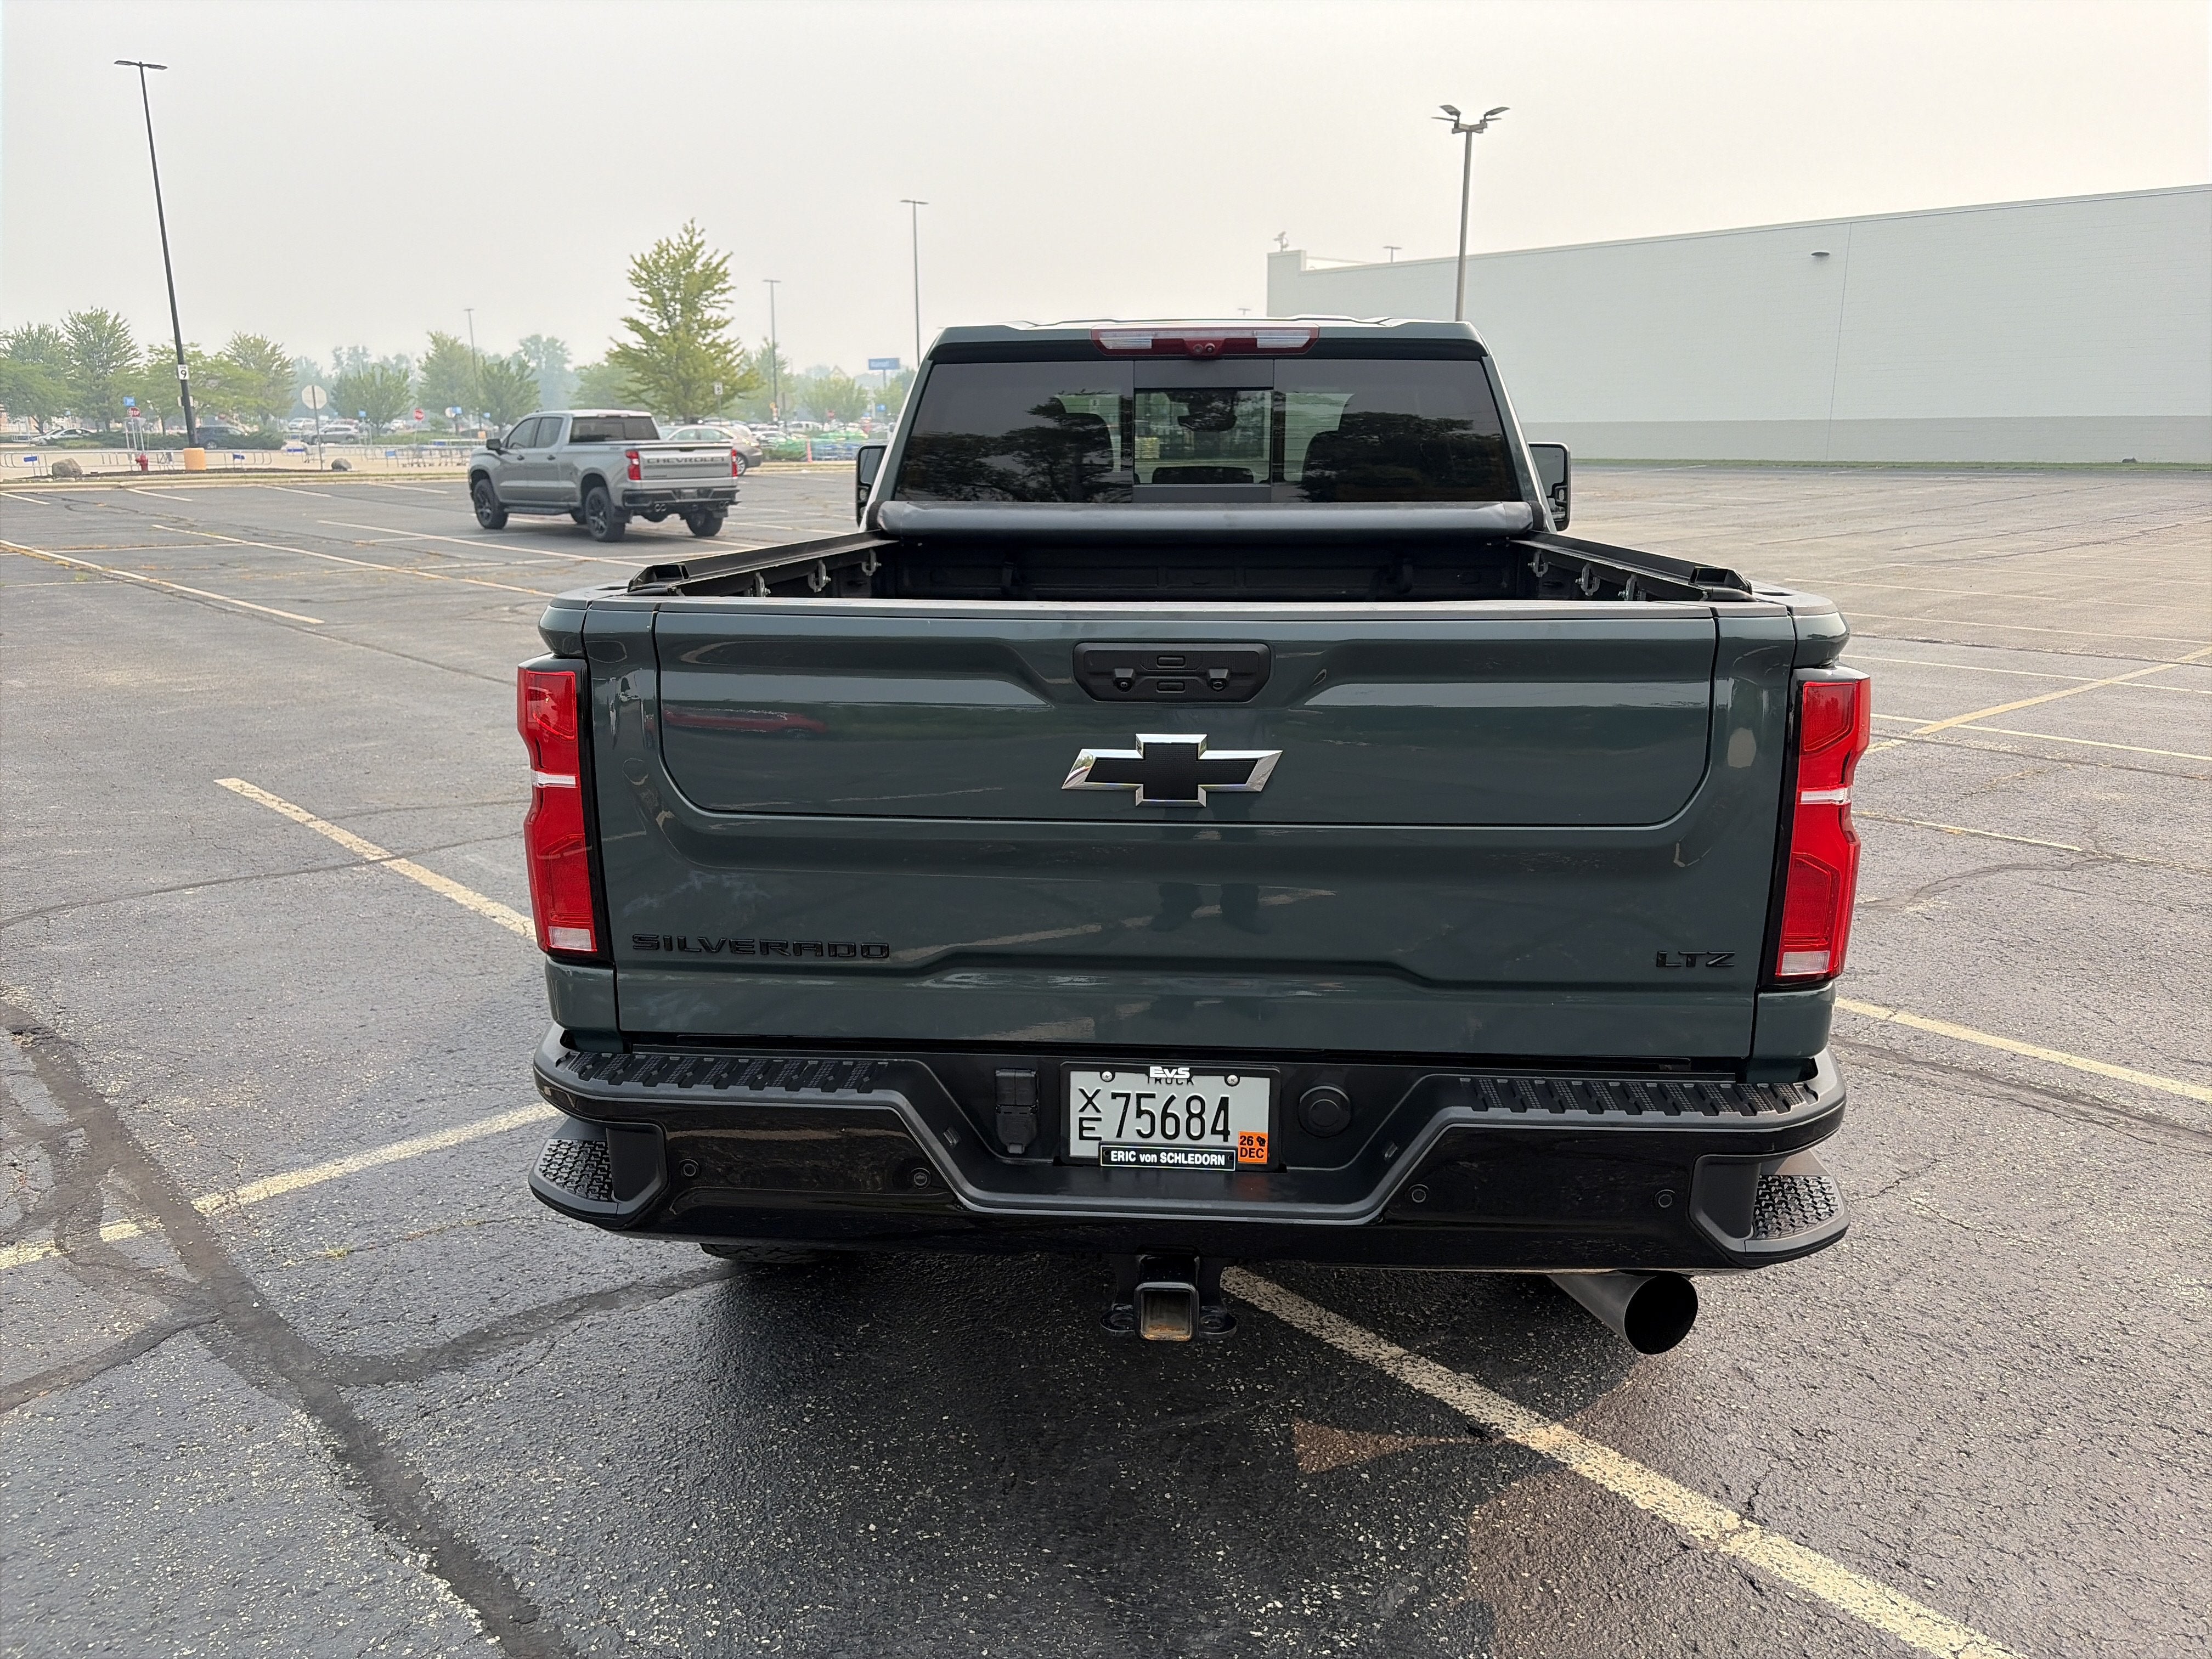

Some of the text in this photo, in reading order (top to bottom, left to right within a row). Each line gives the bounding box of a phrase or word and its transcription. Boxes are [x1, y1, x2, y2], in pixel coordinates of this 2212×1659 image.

[180, 370, 187, 379] 9
[632, 933, 890, 958] SILVERADO
[1656, 951, 1735, 967] LTZ
[1111, 1092, 1231, 1142] 75684
[1239, 1136, 1254, 1146] 26
[1110, 1150, 1226, 1166] ERIC von SCHLEDORN
[1240, 1148, 1265, 1159] DEC
